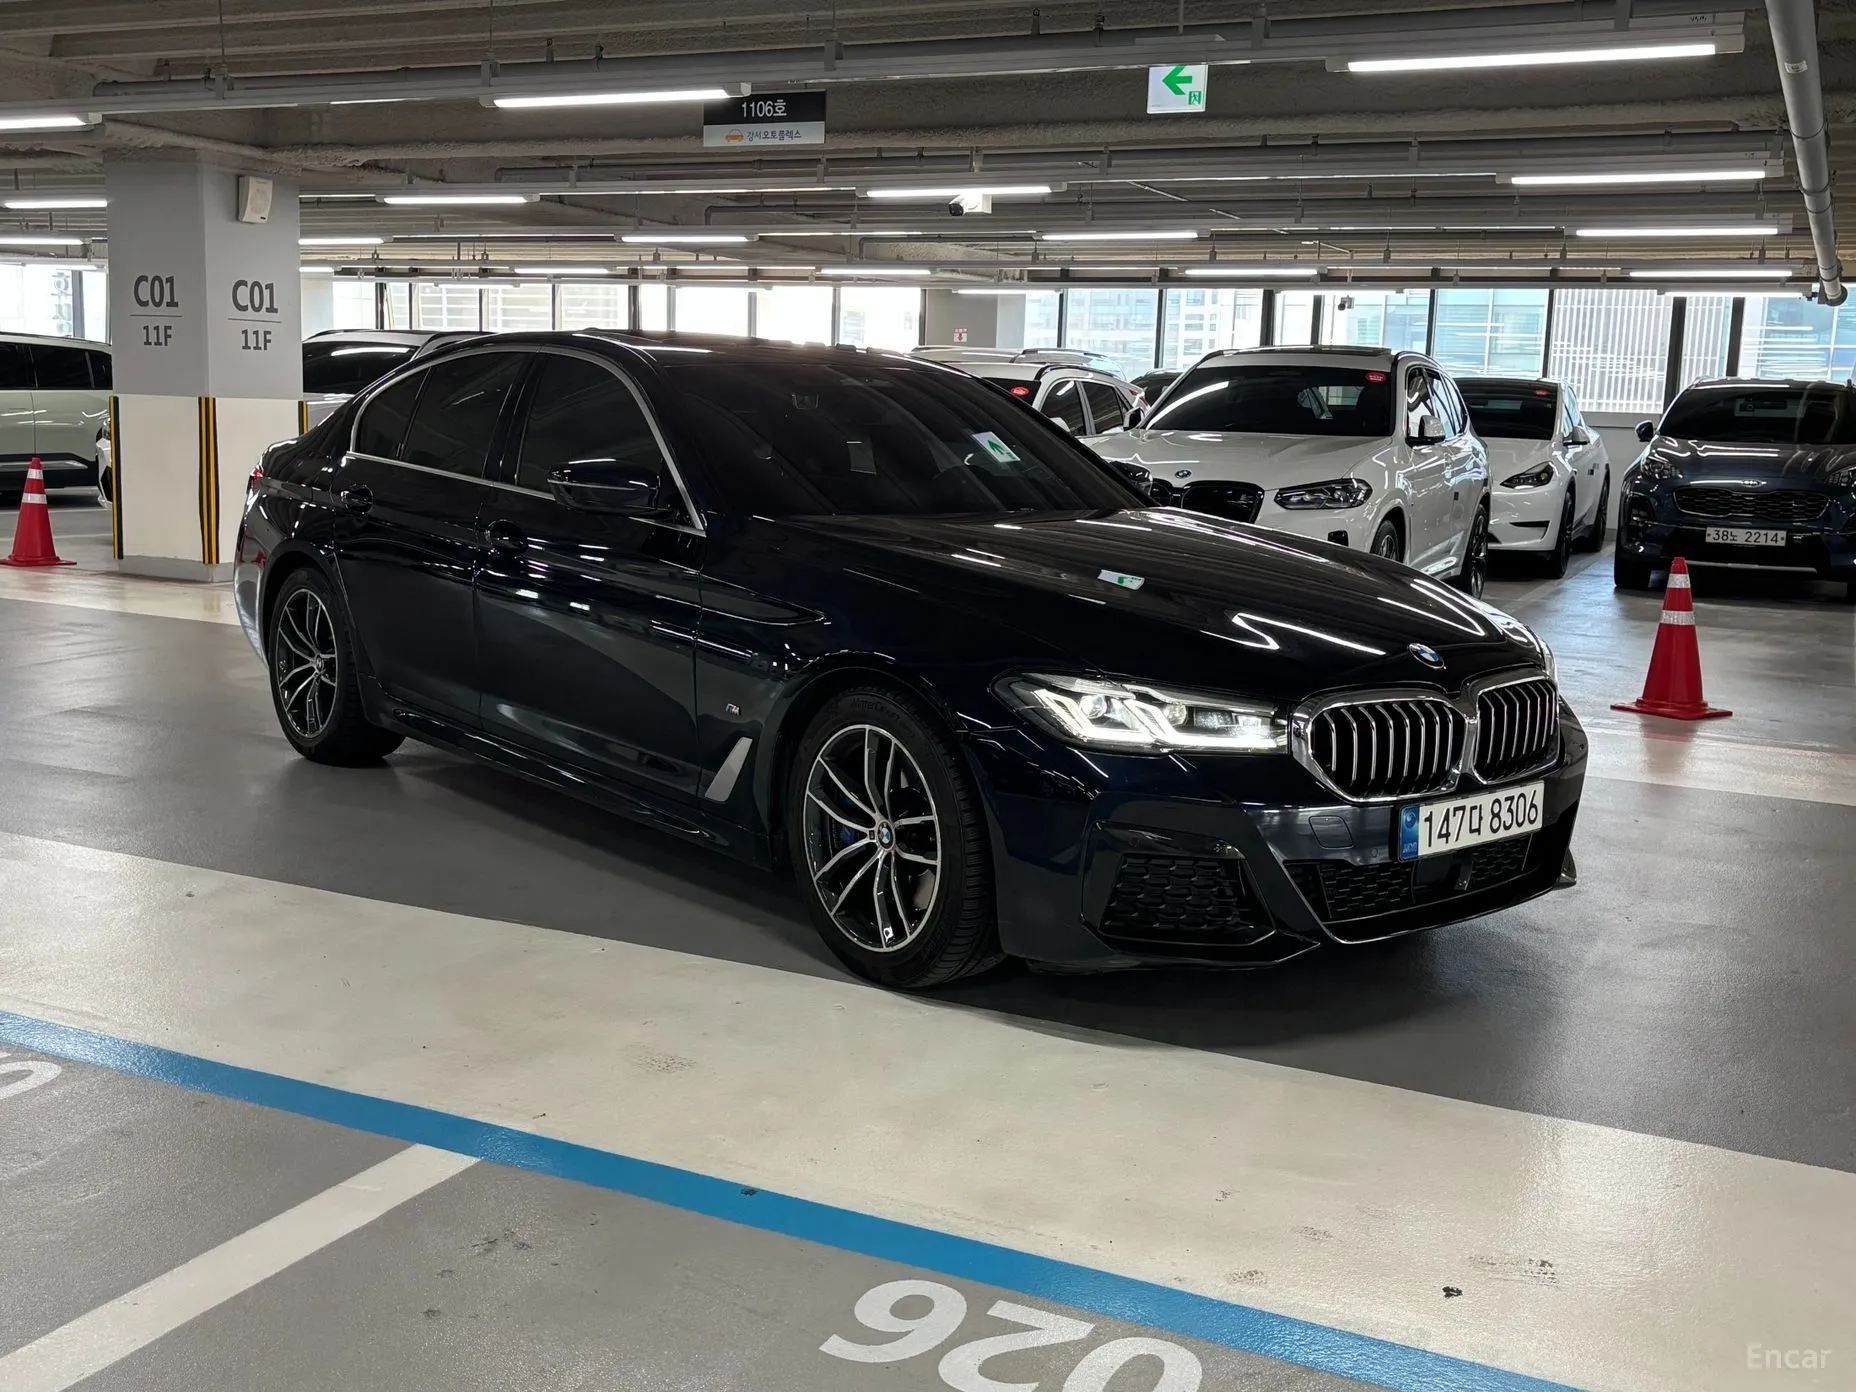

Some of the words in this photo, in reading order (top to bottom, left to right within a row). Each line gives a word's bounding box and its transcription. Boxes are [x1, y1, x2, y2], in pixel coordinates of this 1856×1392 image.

[741, 99, 787, 118] 1106호
[133, 275, 179, 308] C01
[231, 279, 279, 314] C01
[143, 325, 172, 346] 11F
[241, 329, 272, 351] 11F
[1744, 531, 1779, 544] 2214
[1424, 804, 1483, 848] 147다
[1489, 790, 1538, 834] 8306
